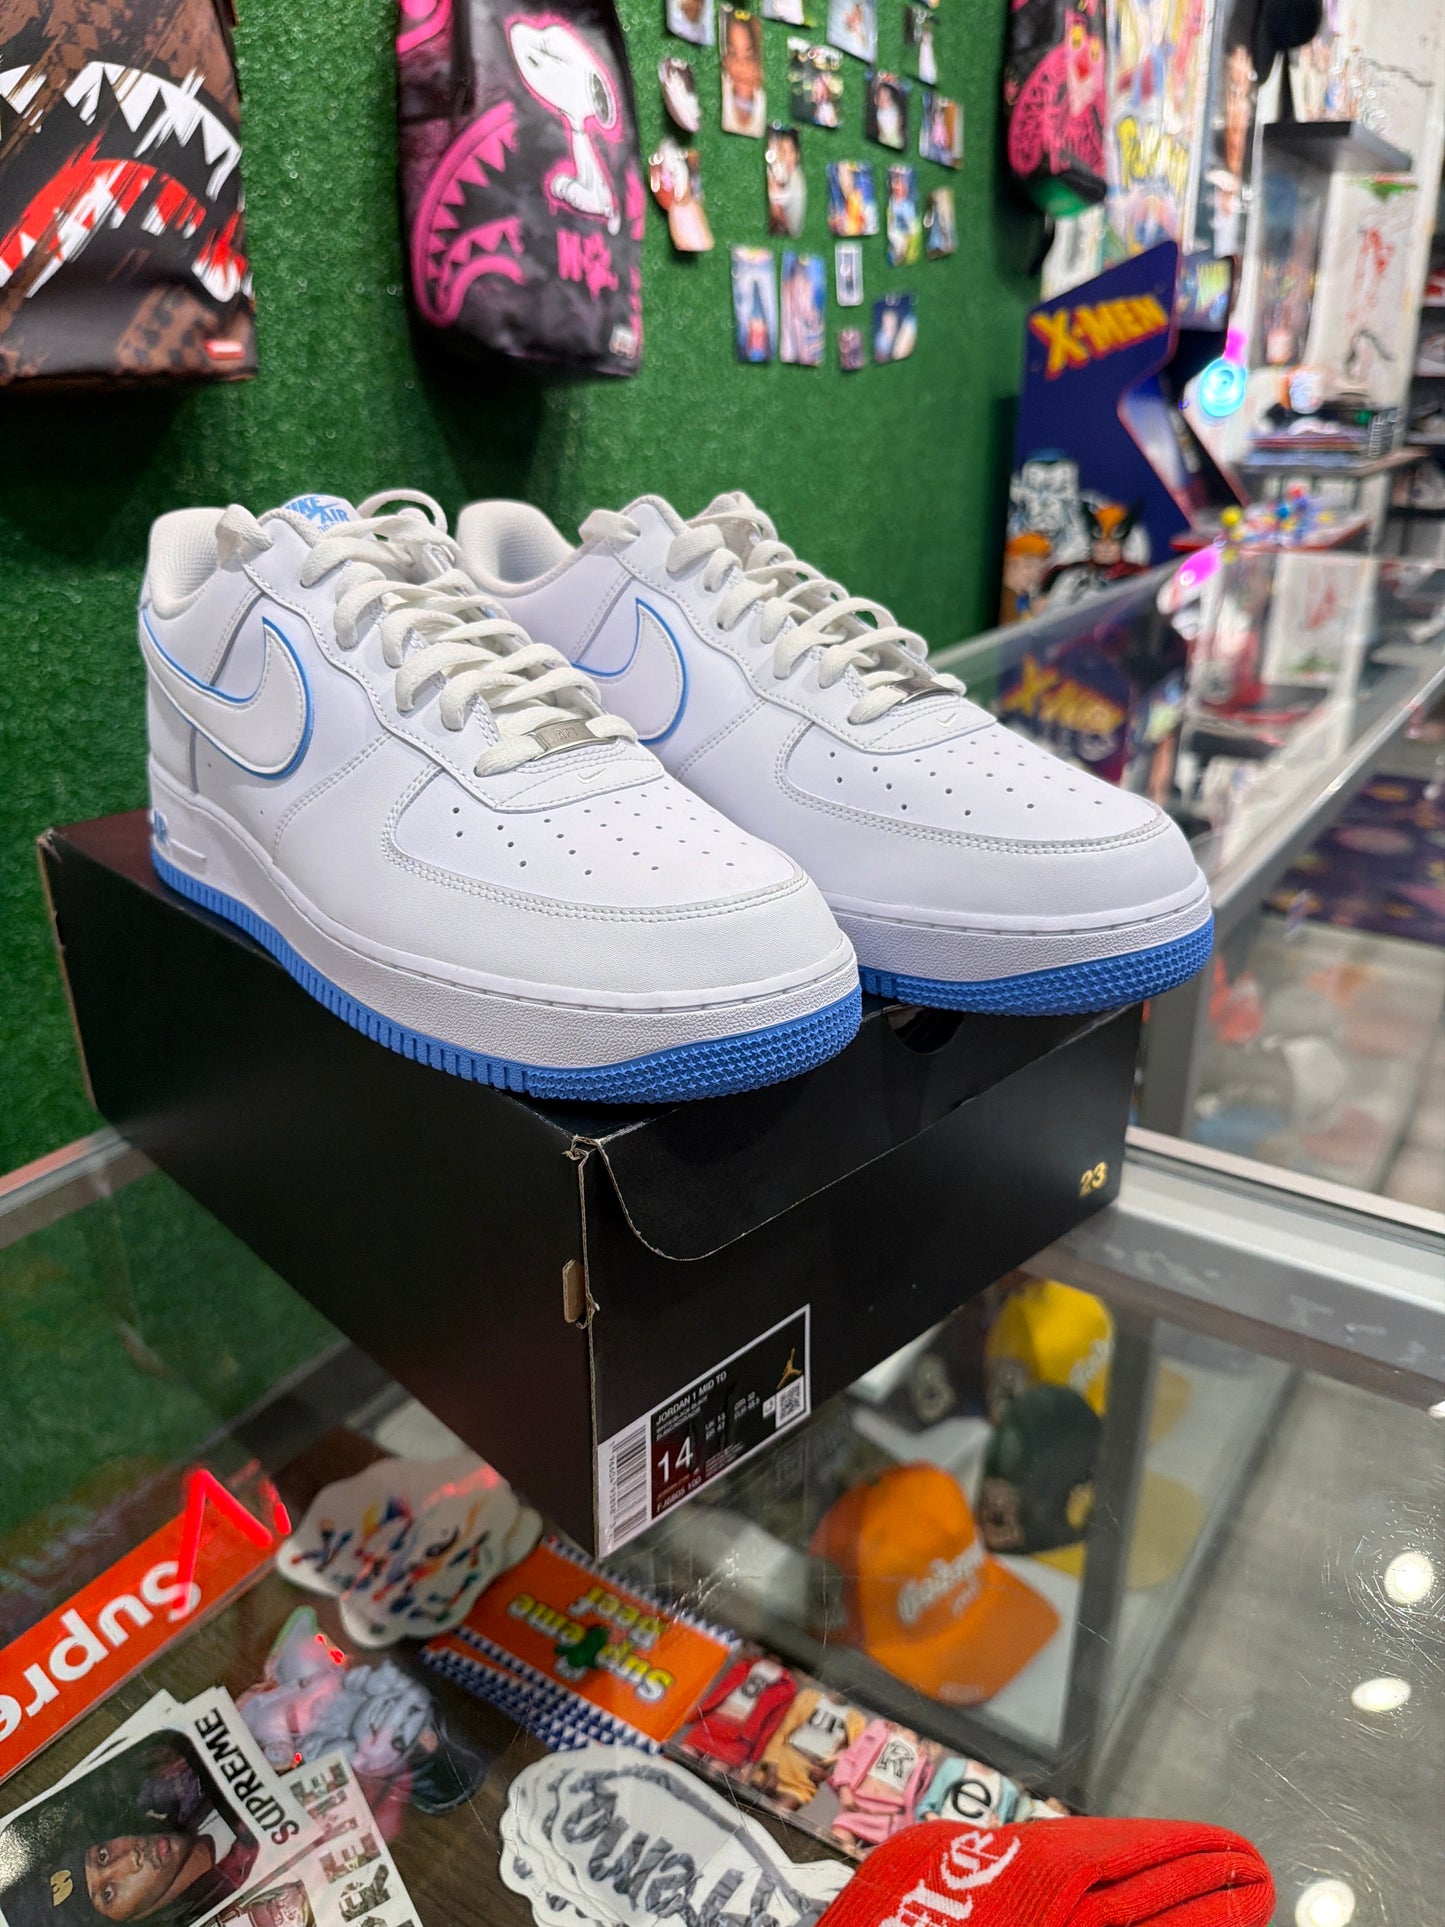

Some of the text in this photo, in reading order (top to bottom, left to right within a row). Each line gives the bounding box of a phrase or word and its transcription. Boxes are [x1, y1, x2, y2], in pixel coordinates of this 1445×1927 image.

[1029, 294, 1168, 381] X-MEN
[320, 508, 350, 524] AIR
[1079, 1160, 1109, 1199] 23
[656, 1394, 691, 1425] JORDAN
[699, 1379, 714, 1396] MID
[657, 1436, 694, 1484] 14
[508, 1593, 674, 1703] Supeme
[195, 1708, 299, 1845] SUPREME
[877, 1739, 918, 1778] R
[951, 1779, 992, 1819] e
[290, 1762, 415, 1927] REME
